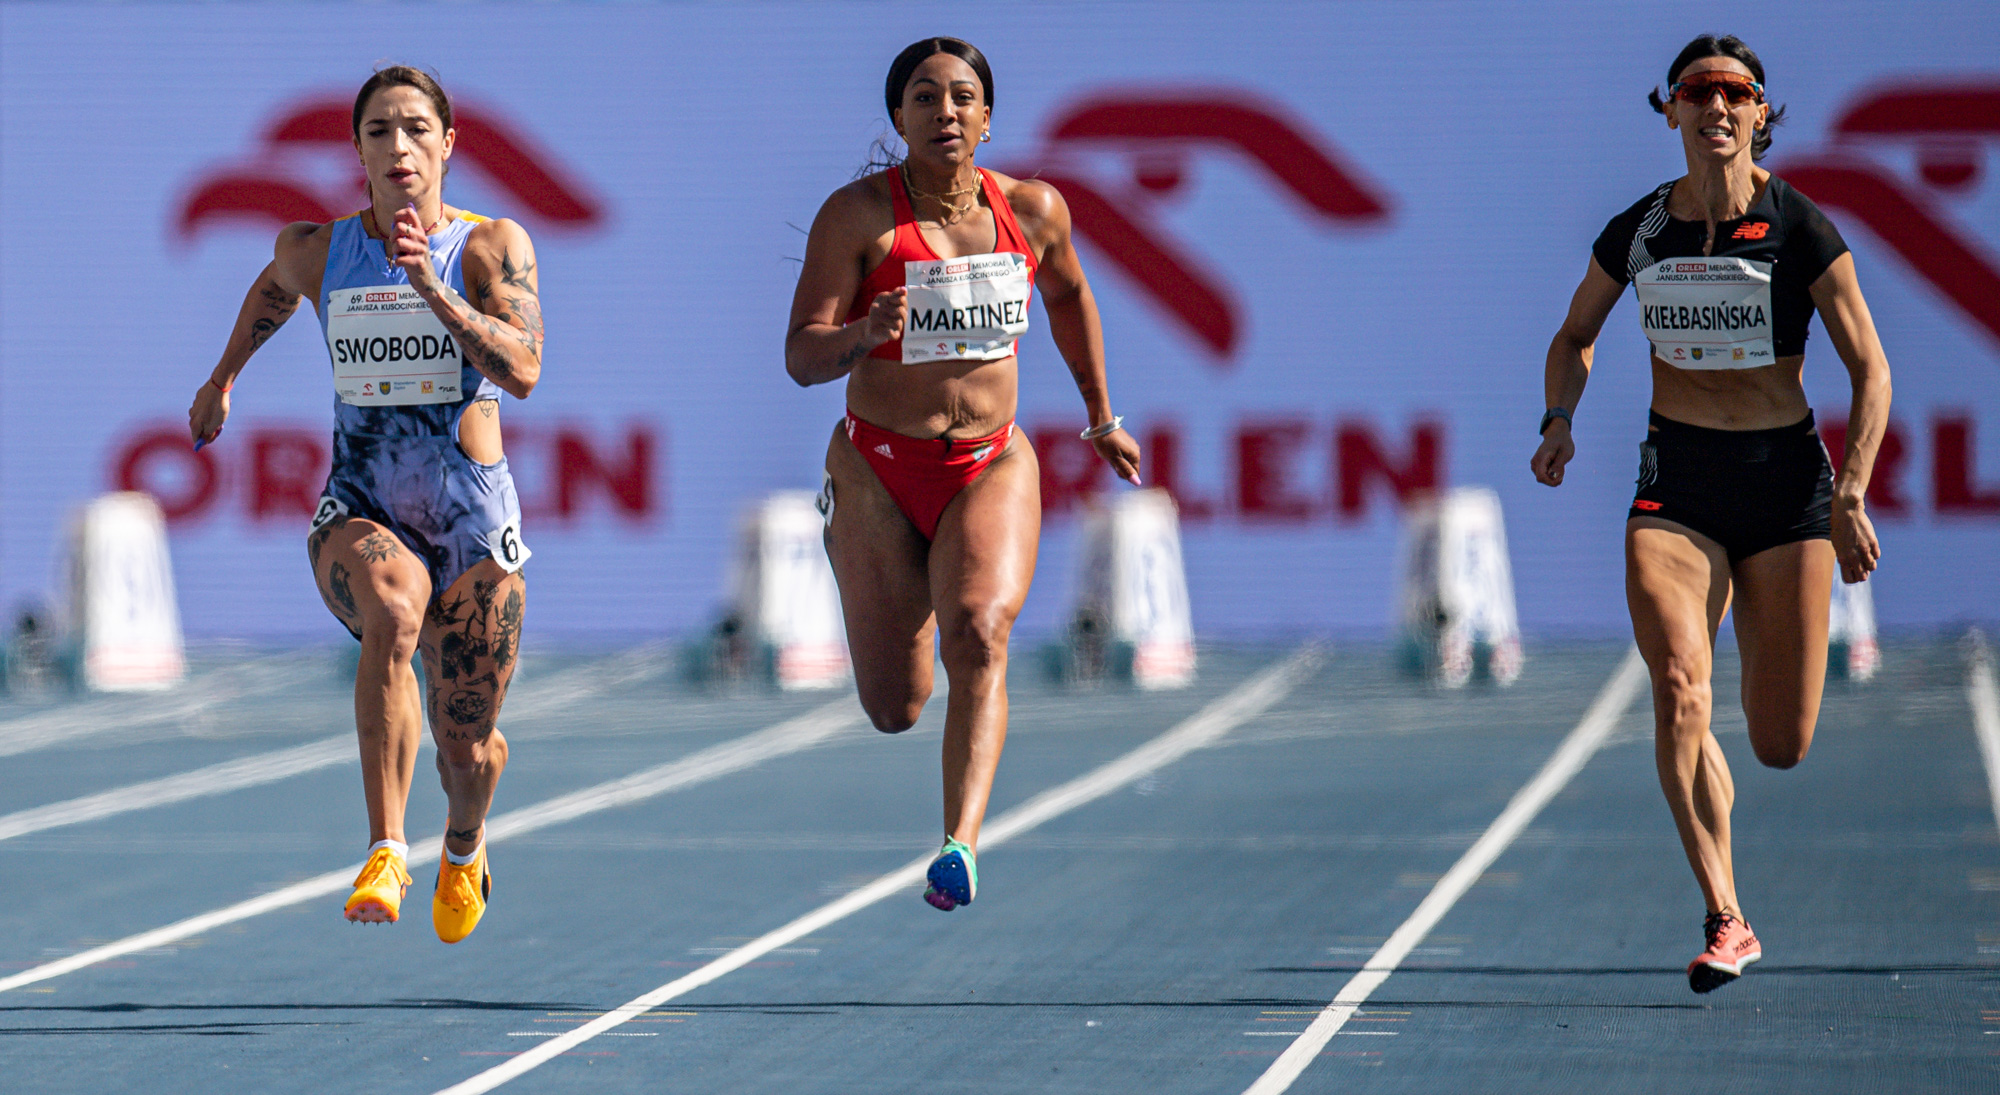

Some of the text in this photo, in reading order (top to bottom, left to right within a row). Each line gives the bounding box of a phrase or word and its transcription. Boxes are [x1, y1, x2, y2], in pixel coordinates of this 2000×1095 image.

[947, 263, 969, 273] ORLEN
[1656, 271, 1750, 281] JANUSZA KUSOCIŃSKIEGO
[1659, 264, 1674, 273] 69.
[1678, 264, 1705, 272] ORLEN
[347, 304, 379, 312] JANUSZA
[350, 292, 421, 304] 69. ORLEN MEMO
[910, 299, 1024, 332] MARTINEZ
[1644, 300, 1767, 331] KIEŁBASIŃSKA
[335, 334, 457, 363] SWOBODA
[1034, 420, 1443, 520] RLEN
[501, 526, 519, 564] 6
